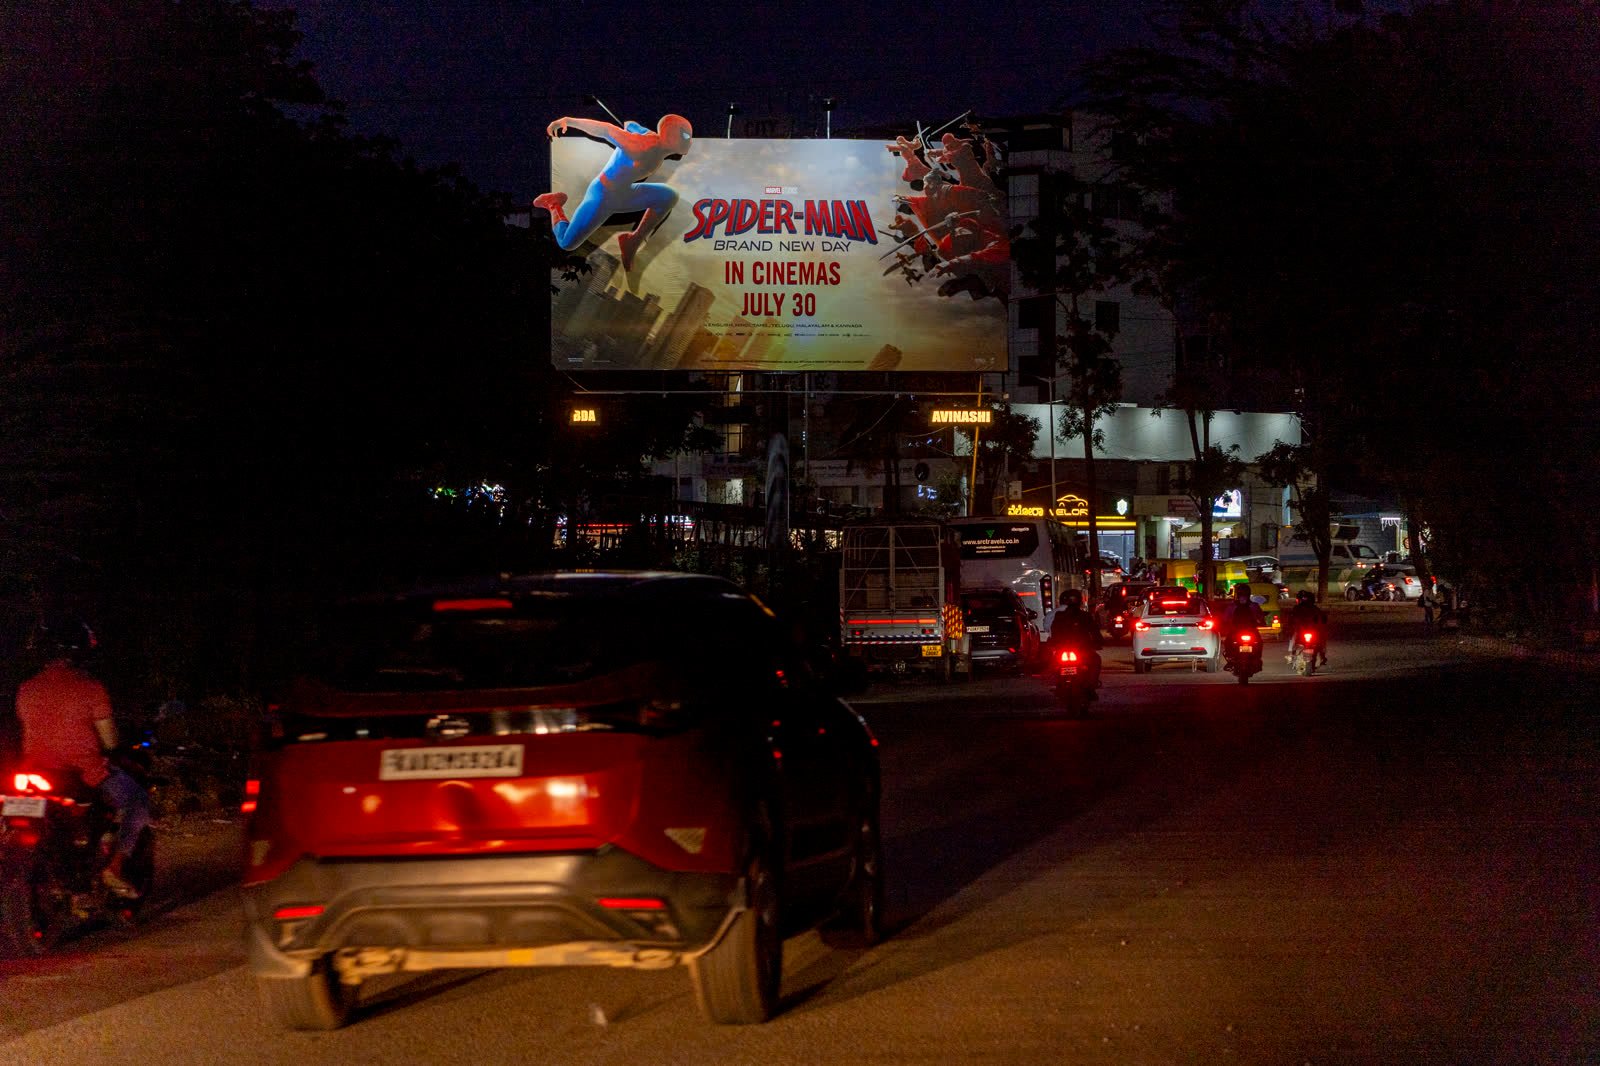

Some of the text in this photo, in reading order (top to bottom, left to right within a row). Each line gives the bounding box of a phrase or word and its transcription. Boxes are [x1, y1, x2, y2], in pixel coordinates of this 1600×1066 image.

[683, 198, 879, 245] SPIDER-MAN
[713, 240, 852, 253] BRAND NEW DAY
[725, 261, 841, 286] IN CINEMAS
[741, 292, 816, 317] JULY 30
[931, 410, 991, 423] AVINASHI
